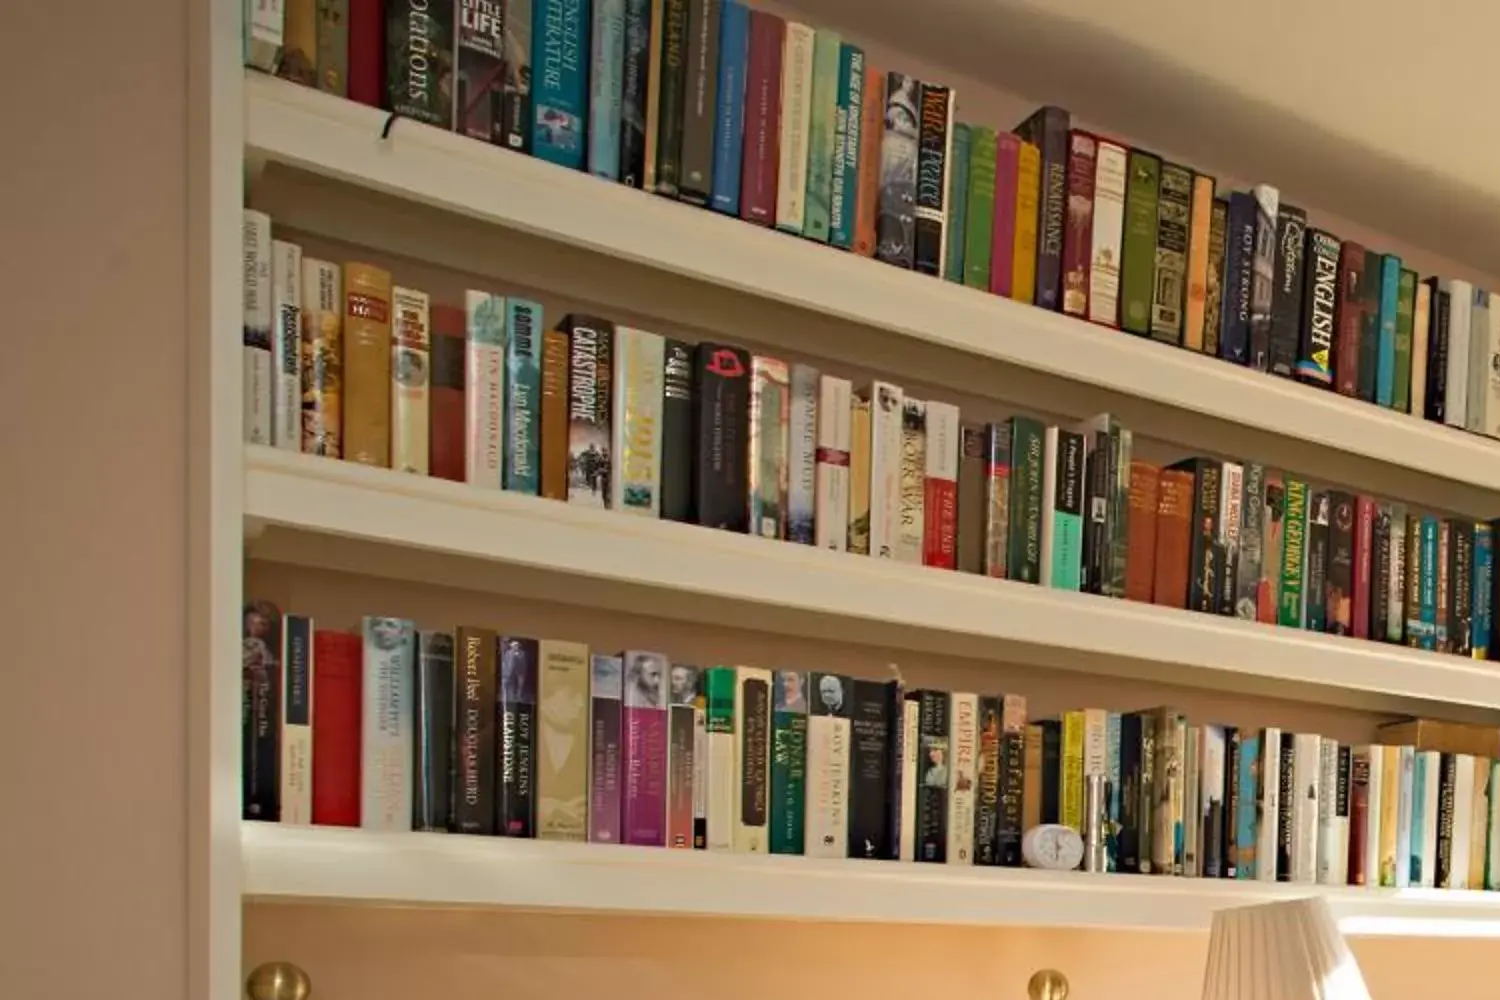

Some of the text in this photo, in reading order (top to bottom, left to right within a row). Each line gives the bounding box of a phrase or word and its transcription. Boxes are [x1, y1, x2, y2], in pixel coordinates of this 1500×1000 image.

[462, 9, 502, 39] LIFE
[849, 73, 862, 88] AGE
[850, 52, 863, 71] THE
[1045, 162, 1064, 258] RENAISSANCE
[1238, 225, 1253, 321] ROY STRONG
[1311, 256, 1338, 348] ENGLISH
[571, 326, 598, 423] CATASTROPHE
[900, 485, 915, 526] WAR
[1287, 481, 1305, 515] KING
[941, 523, 953, 554] END
[1285, 519, 1304, 578] GEORGE
[464, 636, 482, 676] Robert
[463, 708, 480, 767] DOUGLAS
[502, 711, 515, 784] GLADSTONE
[517, 713, 530, 796] ROY JENKINS
[774, 728, 790, 766] LAW
[789, 718, 803, 780] BONAR
[957, 701, 973, 766] EMPIRE
[830, 723, 842, 826] ROY JENKINS
[1004, 737, 1024, 825] Trafalgar
